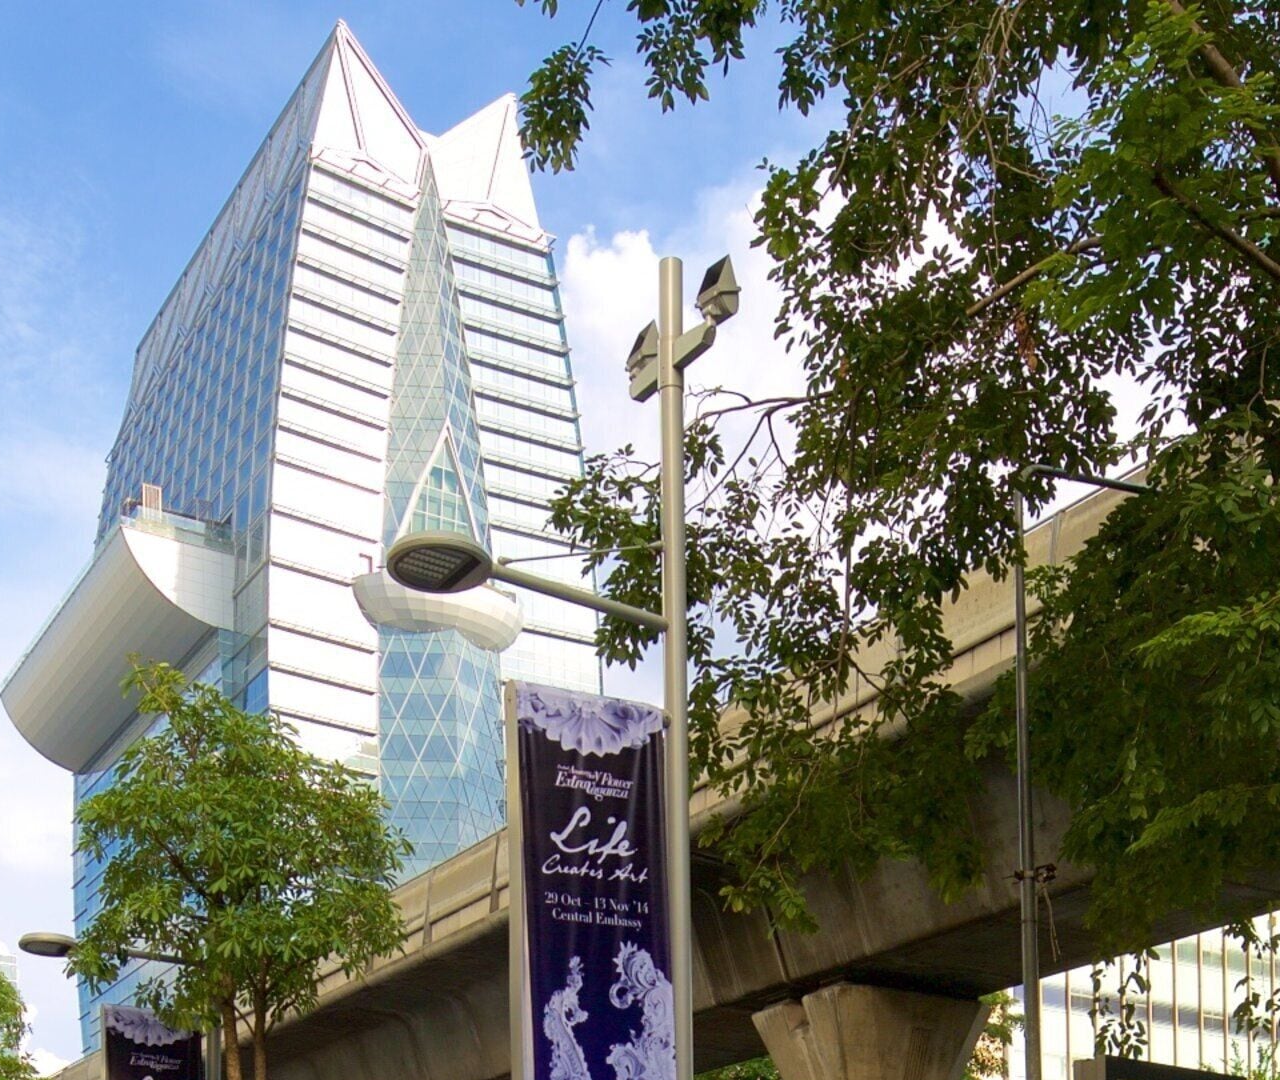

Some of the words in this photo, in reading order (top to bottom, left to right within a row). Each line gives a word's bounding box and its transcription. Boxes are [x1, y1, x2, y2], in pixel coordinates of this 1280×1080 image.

[550, 806, 638, 864] Life
[542, 854, 603, 879] Creates
[608, 862, 648, 883] Art
[544, 891, 558, 904] 29
[561, 894, 581, 906] Oct
[595, 896, 606, 909] 13
[609, 898, 629, 911] Nov
[552, 908, 593, 923] Central
[596, 911, 642, 931] Embassy
